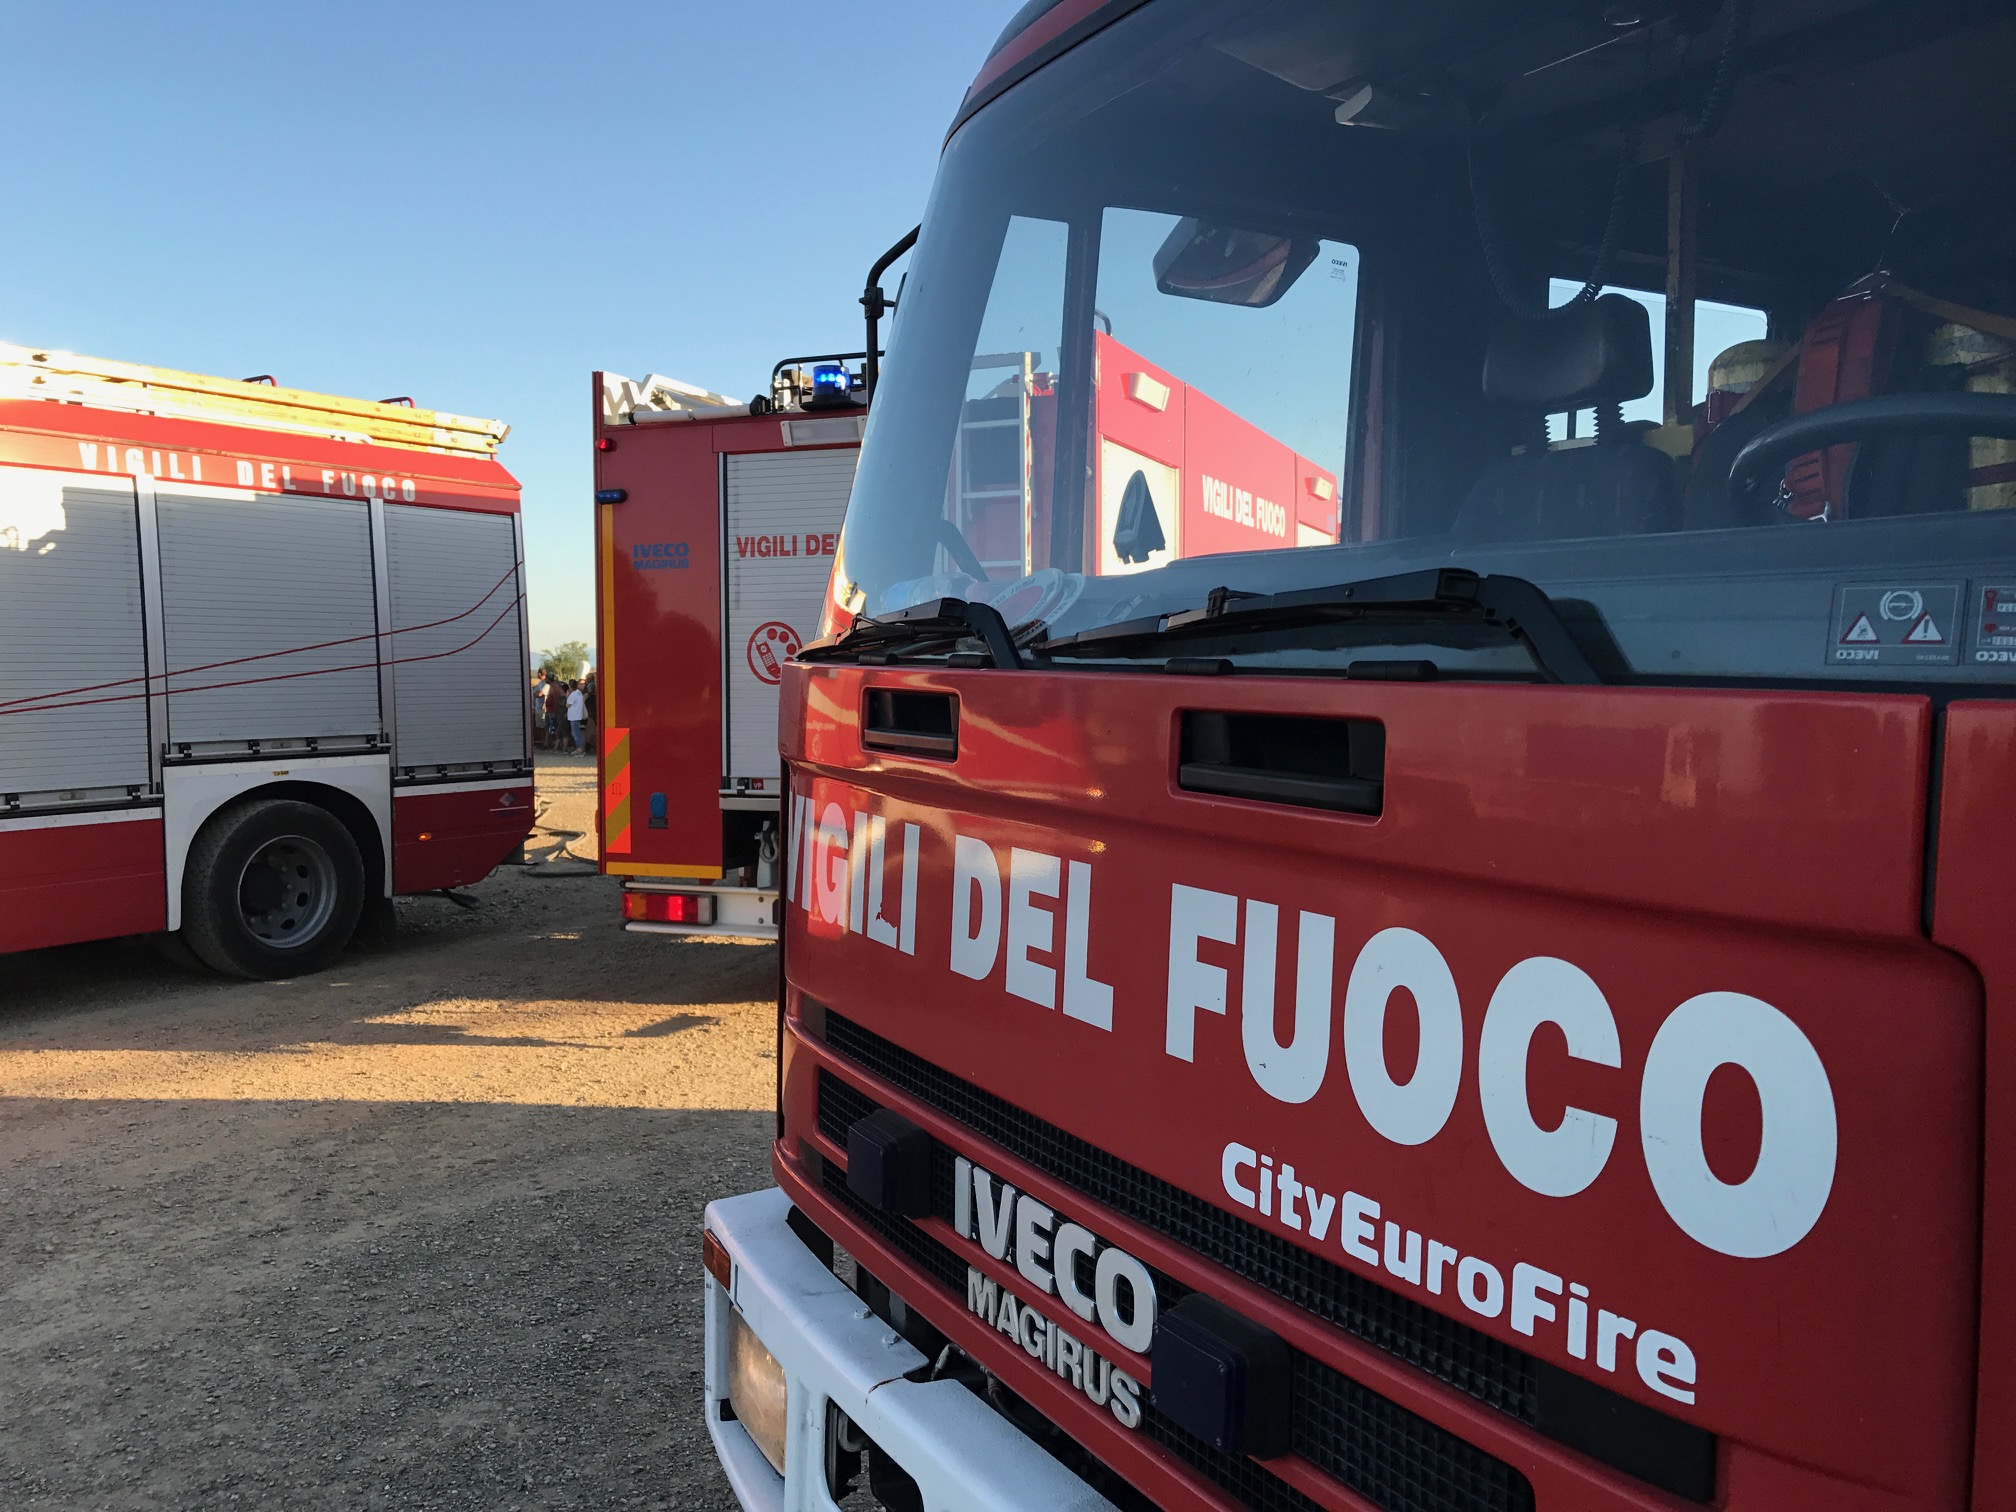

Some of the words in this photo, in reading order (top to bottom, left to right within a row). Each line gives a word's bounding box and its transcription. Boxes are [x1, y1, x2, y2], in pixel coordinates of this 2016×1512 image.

[78, 442, 202, 481] VIGILI
[236, 460, 296, 490] DEL
[321, 470, 416, 502] FUOCO
[1201, 474, 1233, 520] VIGILI
[1235, 488, 1255, 528] DEL
[1256, 496, 1286, 538] FUOCO
[633, 543, 689, 558] IVECO
[633, 558, 690, 570] MAGIRUS
[736, 534, 798, 558] VIGILI
[787, 790, 921, 957] VIGILI
[949, 834, 1114, 1033] DEL
[1166, 882, 1838, 1259] FUOCO
[954, 1155, 1158, 1354] IVECO
[1221, 1141, 1698, 1406] CityEuroFire
[967, 1265, 1142, 1429] MAGIRUS
